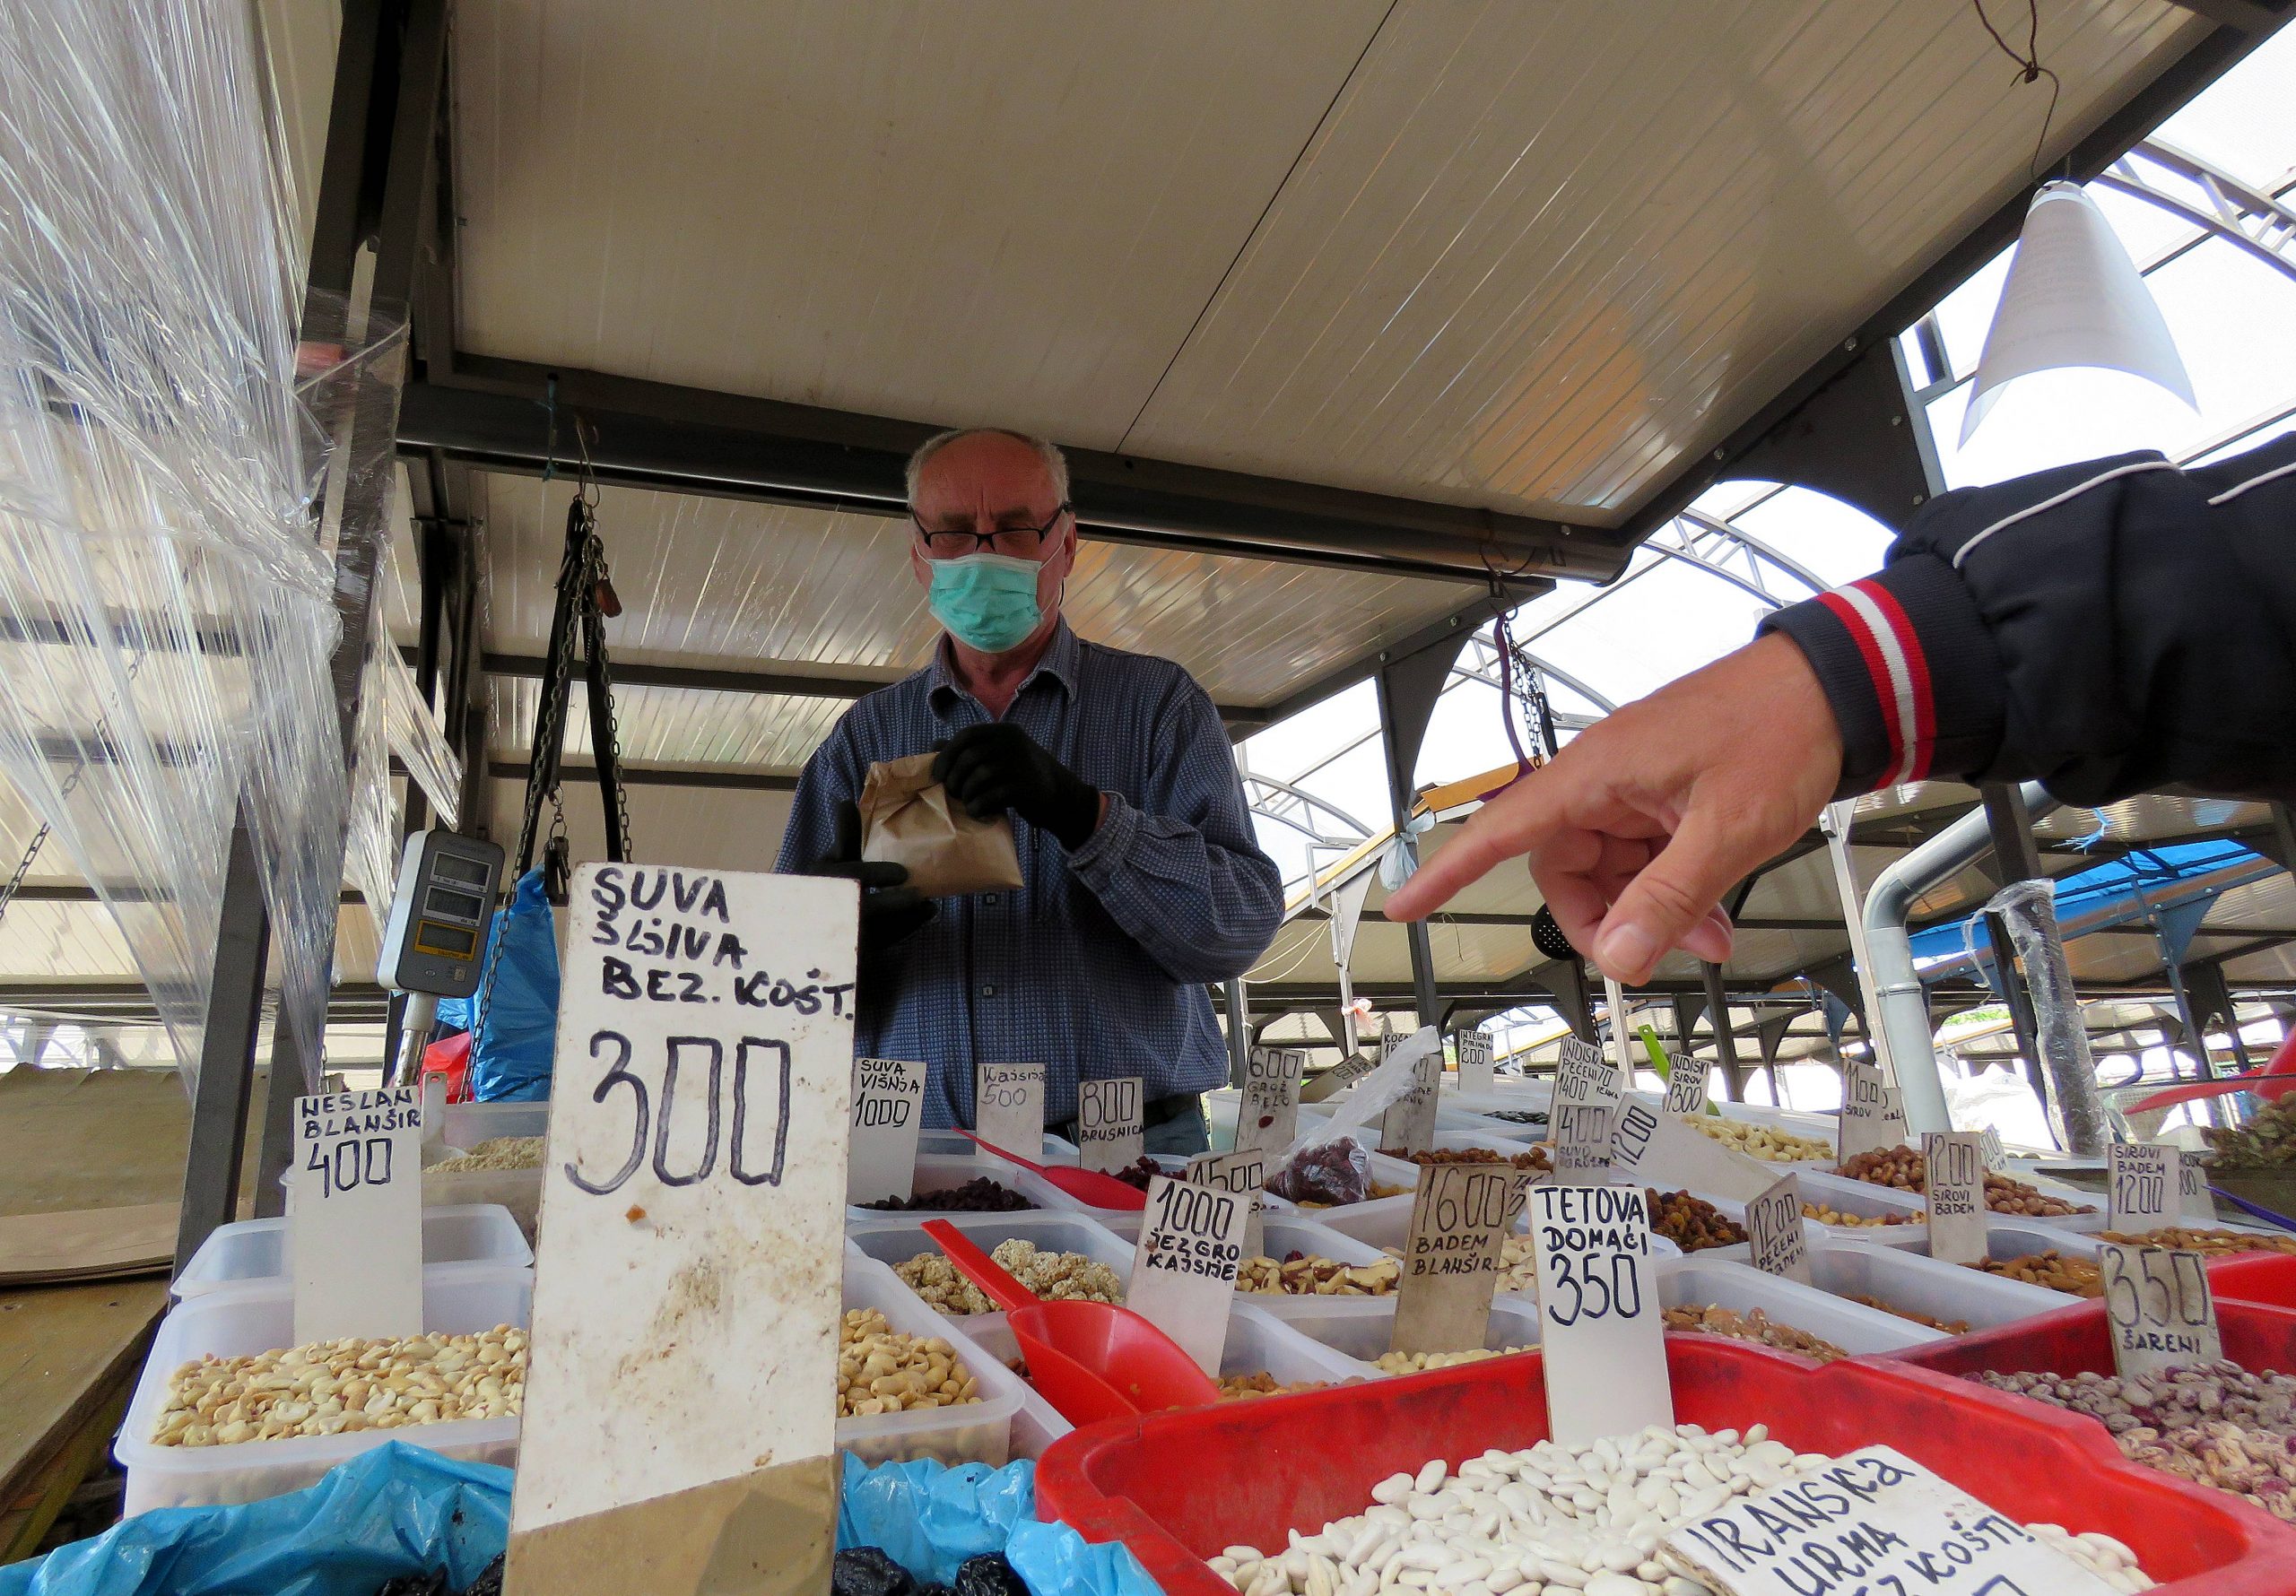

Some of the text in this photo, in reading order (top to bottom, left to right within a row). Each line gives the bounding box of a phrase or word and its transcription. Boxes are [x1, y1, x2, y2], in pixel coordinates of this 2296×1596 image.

[591, 867, 730, 922] SUVA
[861, 1060, 906, 1075] SUVA
[1249, 1048, 1299, 1079] 600
[1462, 1047, 1484, 1064] 200
[1558, 1072, 1587, 1100] 1400
[1674, 1071, 1701, 1084] SIROV
[1845, 1062, 1878, 1103] 1100
[302, 1089, 412, 1118] NESLAN
[856, 1091, 910, 1127] 1000
[980, 1084, 1027, 1107] 500
[1082, 1080, 1135, 1127] 800
[1666, 1082, 1702, 1113] 1300
[1845, 1105, 1871, 1117] SIROV
[304, 1108, 422, 1139] BLANŠIR
[564, 1030, 791, 1195] 300
[1561, 1106, 1605, 1144] 400
[1081, 1124, 1144, 1143] BRUSNICA
[1611, 1105, 1657, 1166] 1200
[307, 1138, 392, 1198] 400
[1927, 1133, 1974, 1187] 1200
[2115, 1145, 2161, 1159] SIROVI
[2118, 1160, 2165, 1176] BADEM
[1156, 1180, 1234, 1241] 1000
[1422, 1167, 1507, 1232] 1600
[1535, 1187, 1645, 1224] TETOVA
[1933, 1189, 1970, 1201] SIROVI
[2116, 1174, 2163, 1214] 1200
[1753, 1193, 1796, 1254] 1200
[1415, 1234, 1489, 1254] BADEM
[1146, 1253, 1236, 1281] KAJSIJE
[1549, 1253, 1640, 1326] 350
[2108, 1246, 2208, 1328] 350
[2123, 1328, 2201, 1355] ŠARENI
[1771, 1522, 1909, 1596] URMA
